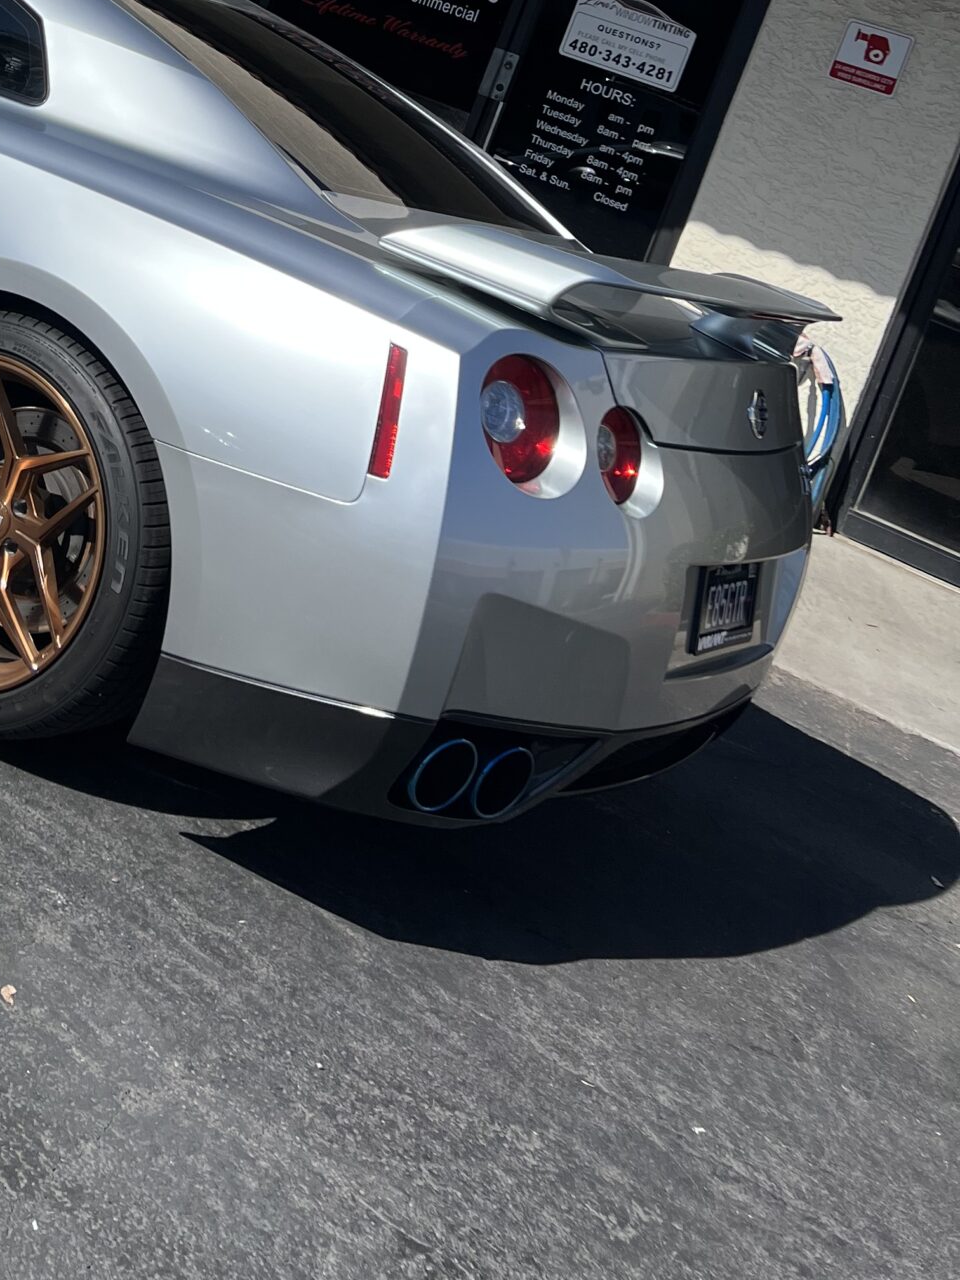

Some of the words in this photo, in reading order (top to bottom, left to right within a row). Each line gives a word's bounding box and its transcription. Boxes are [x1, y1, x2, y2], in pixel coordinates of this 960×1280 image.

[383, 14, 470, 59] Warranty
[577, 30, 599, 43] PLEASE
[601, 38, 616, 49] CALL
[617, 43, 627, 52] MY
[628, 47, 644, 58] CELL
[644, 52, 666, 65] PHONE
[597, 24, 662, 51] QUESTIONS?
[651, 19, 691, 39] TINTING
[545, 89, 585, 112] Monday
[636, 124, 655, 135] pm
[580, 78, 637, 108] HOURS:
[536, 119, 590, 147] Wednesday
[621, 151, 644, 166] 4pm
[542, 104, 582, 128] Tuesday
[596, 125, 619, 140] 8am
[524, 148, 555, 168] Friday
[580, 170, 603, 185] 8am
[615, 185, 633, 197] pm
[531, 133, 575, 159] Thursday
[586, 155, 609, 170] 8am
[616, 166, 639, 181] 4pm
[518, 164, 537, 178] Sat.
[539, 171, 548, 182] &
[549, 175, 571, 191] Sun.
[593, 192, 629, 212] Closed
